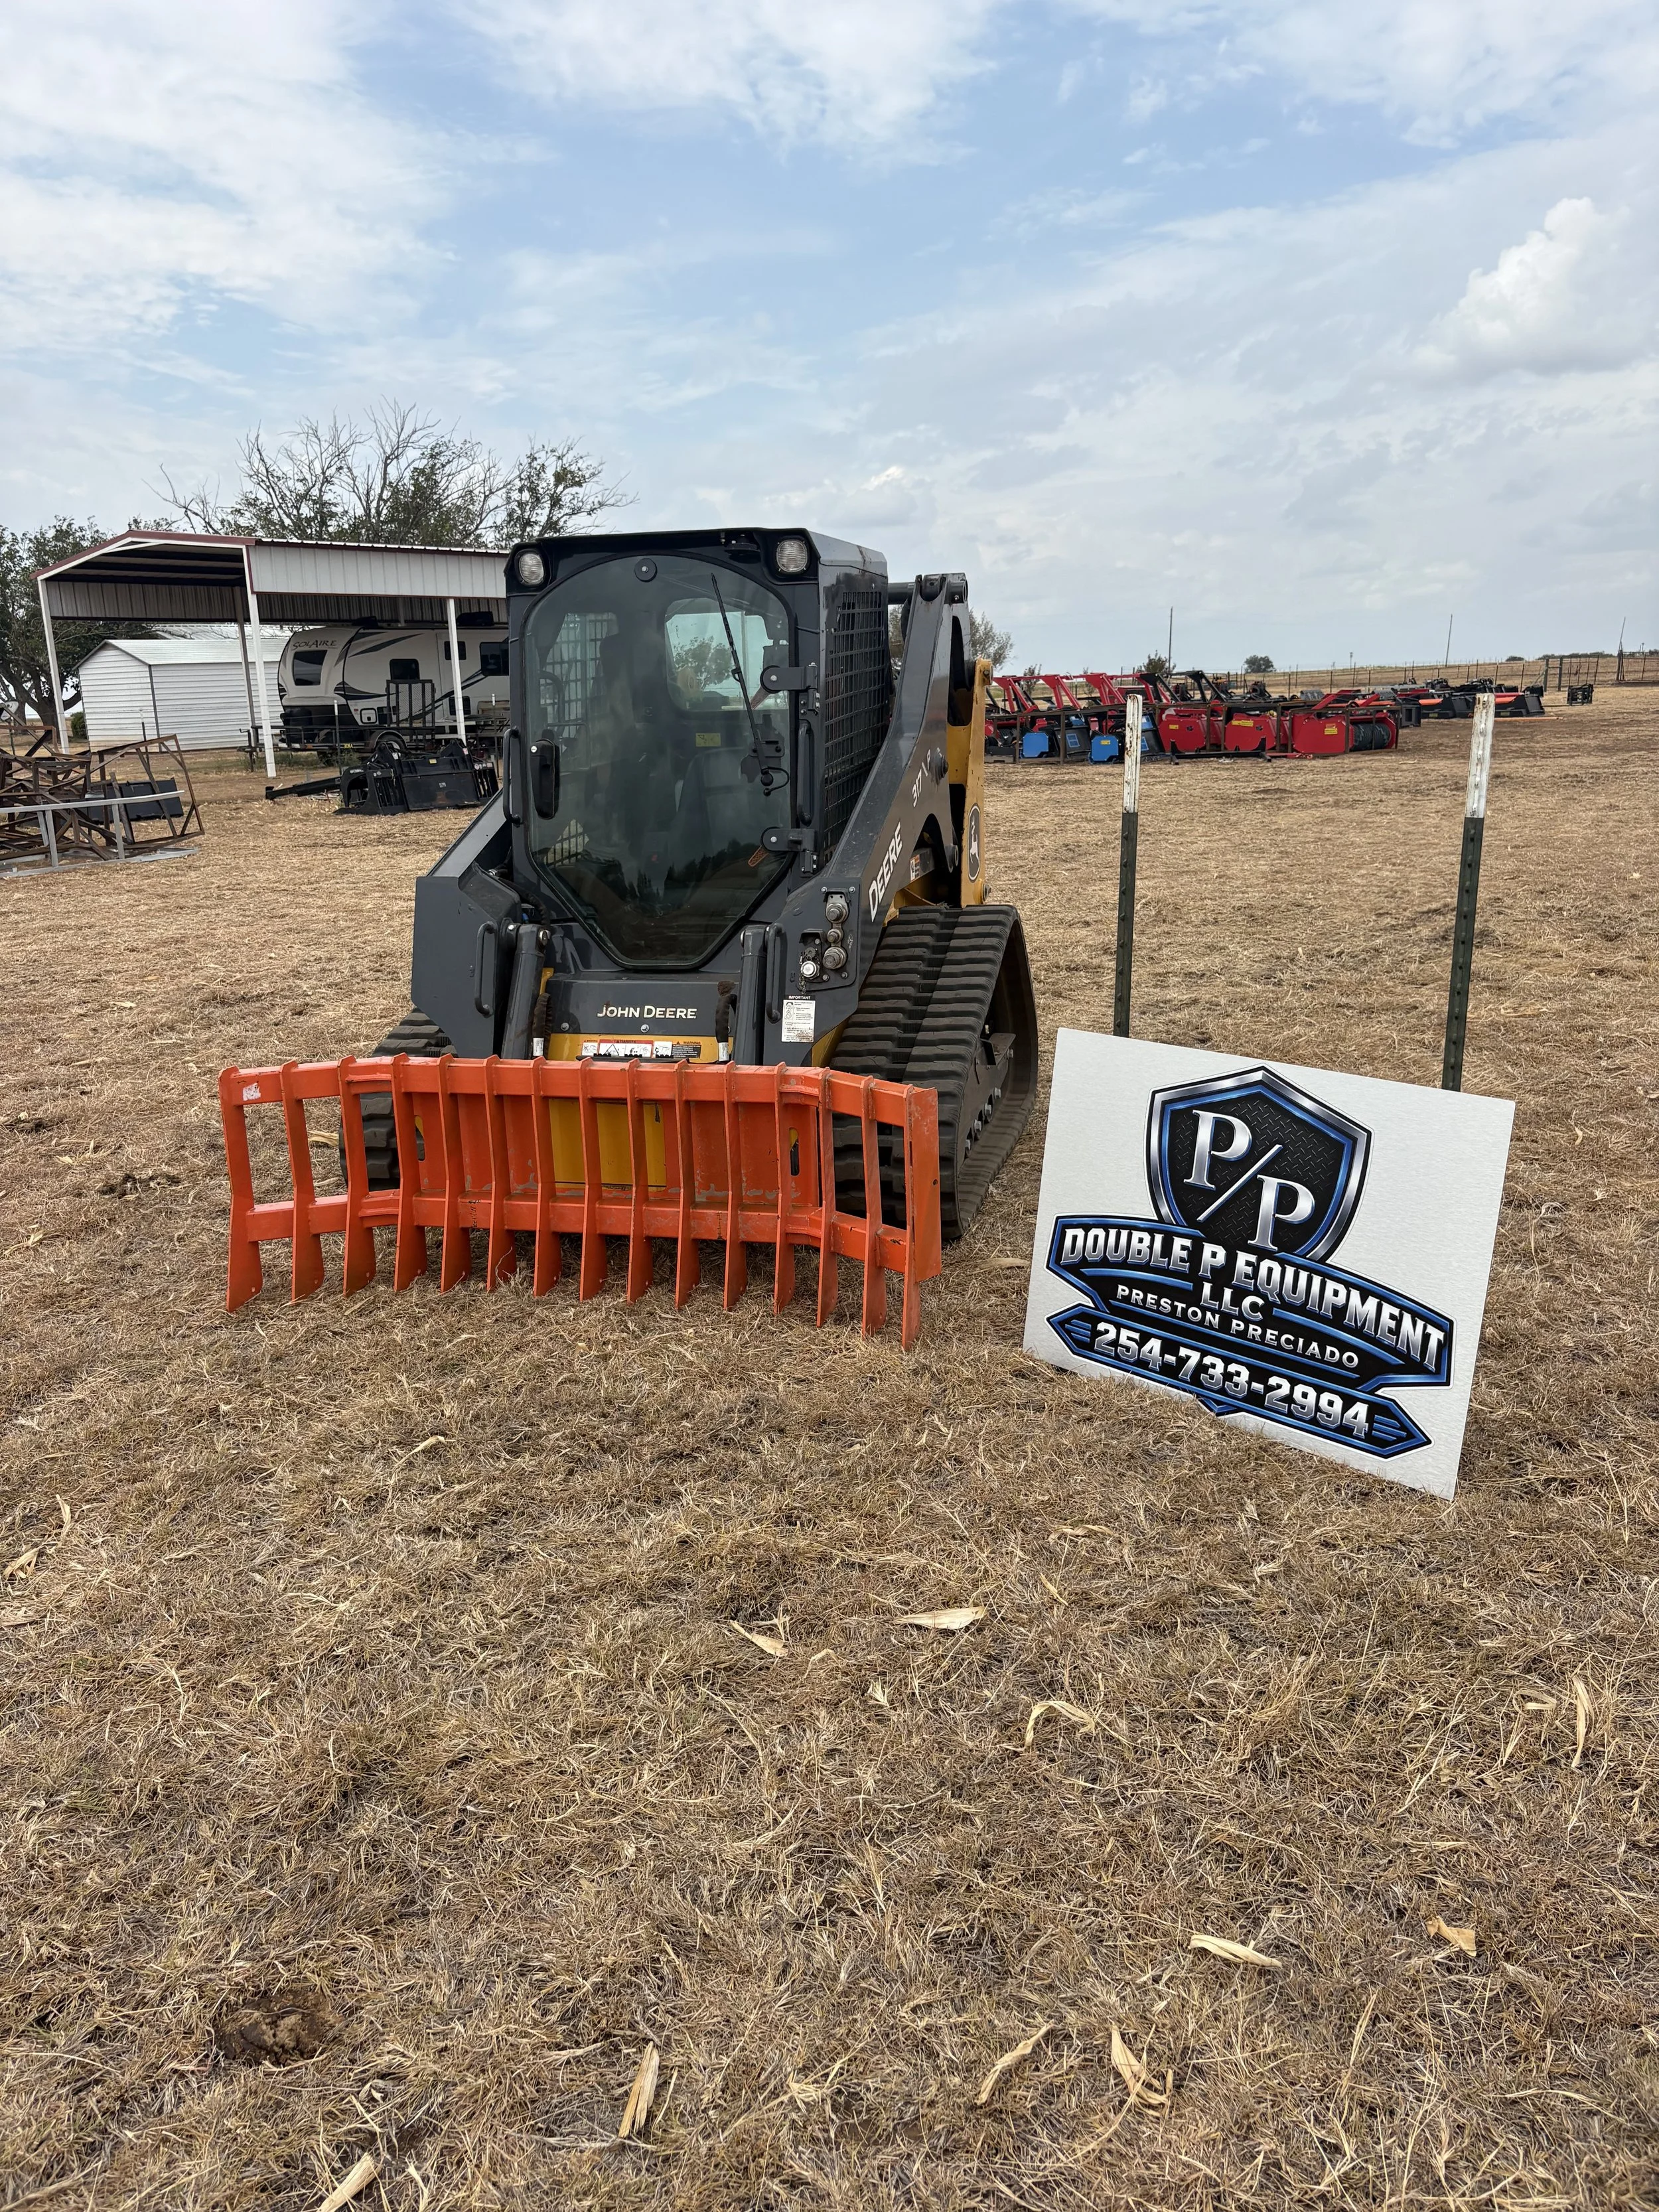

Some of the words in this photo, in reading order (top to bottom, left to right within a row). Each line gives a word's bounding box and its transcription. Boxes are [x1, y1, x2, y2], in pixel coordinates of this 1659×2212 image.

[868, 821, 902, 923] DEERE
[597, 1004, 640, 1018] JOHN
[643, 1005, 697, 1019] DEERE
[1060, 1228, 1193, 1273] DOUBLE
[1198, 1242, 1227, 1279] P
[1231, 1250, 1445, 1373] EQUIPMENT
[1116, 1284, 1220, 1329] PRESTON
[1230, 1318, 1359, 1368] PRECIADO
[1200, 1282, 1265, 1322] LLC
[1094, 1321, 1370, 1439] 254-733-2994
